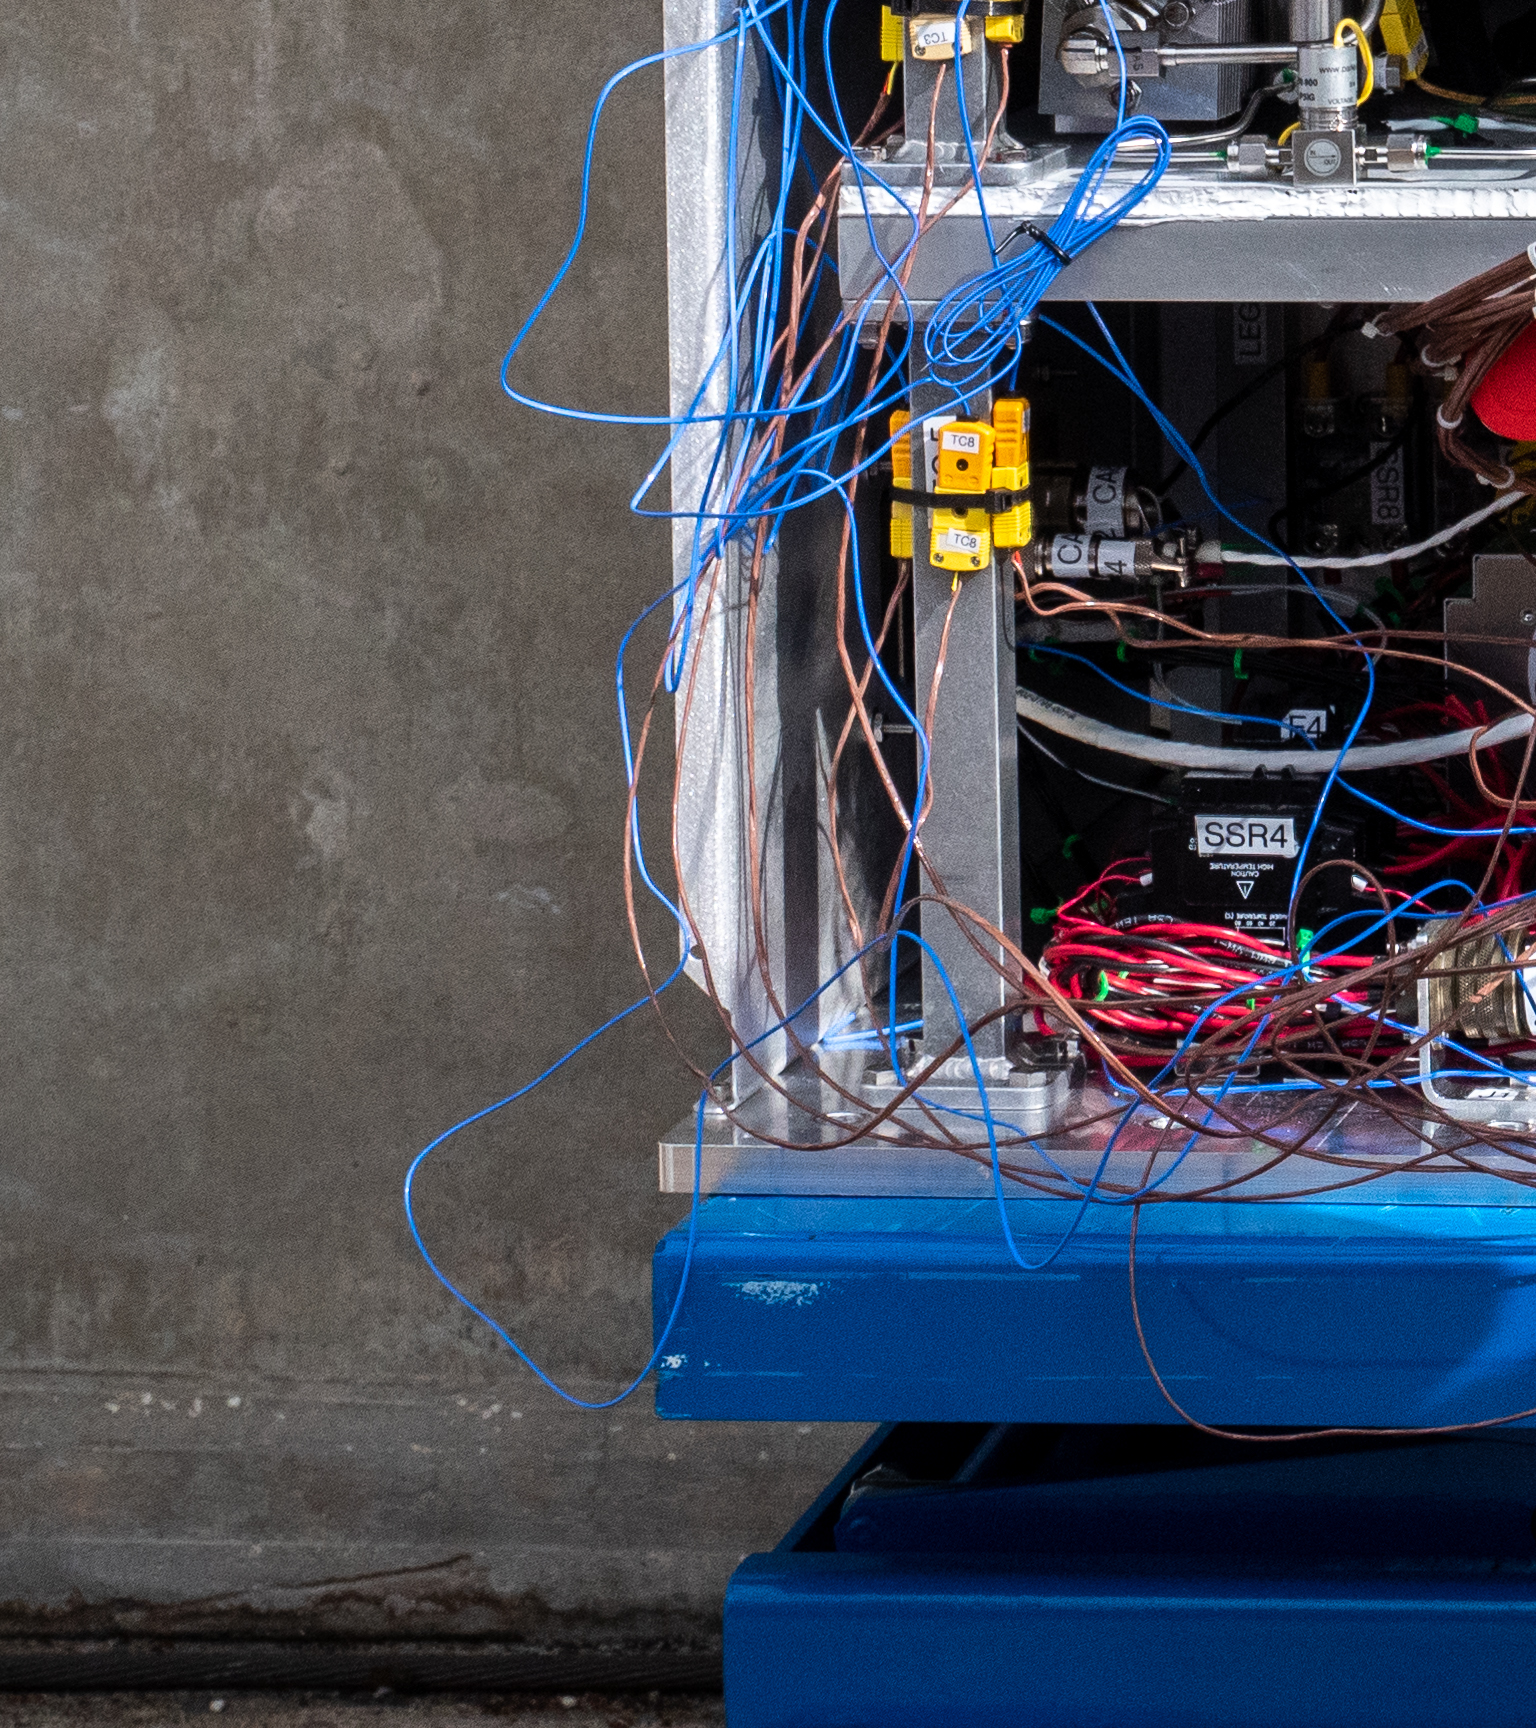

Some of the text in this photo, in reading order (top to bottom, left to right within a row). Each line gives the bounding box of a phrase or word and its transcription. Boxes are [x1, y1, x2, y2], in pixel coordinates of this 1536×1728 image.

[922, 32, 948, 45] TC3
[951, 434, 975, 448] TC8
[952, 533, 978, 549] TC8
[1289, 715, 1322, 740] F4
[1204, 821, 1289, 849] SSR4
[1209, 862, 1256, 871] TEMPERATURE
[1230, 870, 1260, 878] CAUTION
